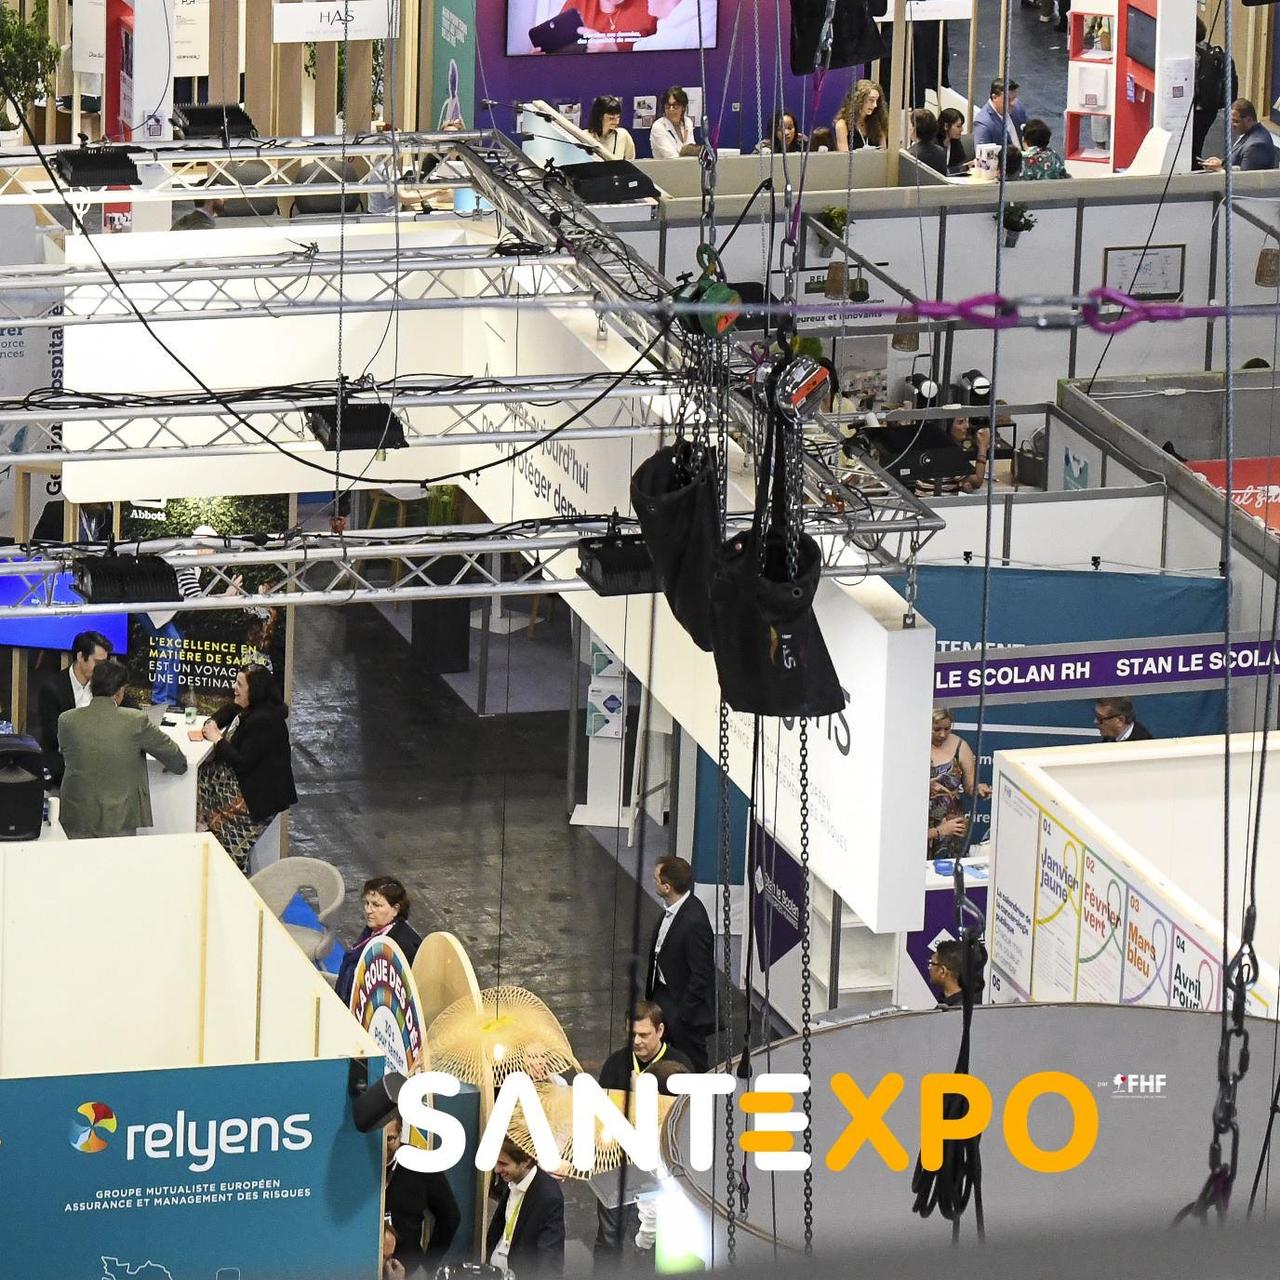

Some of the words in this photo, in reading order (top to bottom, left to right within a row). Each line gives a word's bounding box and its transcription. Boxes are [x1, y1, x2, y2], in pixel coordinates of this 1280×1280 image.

[319, 10, 354, 26] HAS
[130, 509, 167, 521] Abbott
[149, 636, 237, 653] L'EXCELLENCE
[149, 649, 202, 662] MATIÈRE
[205, 654, 223, 665] DE
[149, 660, 170, 671] EST
[172, 662, 191, 673] UN
[148, 672, 174, 684] UNE
[935, 670, 962, 690] LE
[967, 663, 1055, 688] SCOLAN
[1060, 660, 1091, 680] RH
[1115, 656, 1172, 678] STAN
[1177, 652, 1204, 672] LE
[1042, 818, 1052, 837] 01
[1040, 847, 1080, 892] Janvier
[1085, 854, 1096, 875] 02
[1039, 867, 1069, 904] jaune
[1082, 880, 1123, 931] Février
[1129, 894, 1141, 913] 03
[1082, 905, 1107, 940] vert
[1127, 921, 1157, 961] Mars
[1175, 935, 1186, 954] 04
[1126, 943, 1151, 979] bleu
[364, 958, 388, 995] ROUE
[389, 967, 407, 1010] DES
[991, 974, 1002, 993] 05
[1173, 962, 1202, 998] Avril
[126, 1109, 313, 1173] relyens
[95, 1187, 143, 1199] GROUPE
[145, 1183, 217, 1197] MUTUALISTE
[219, 1178, 281, 1191] EUROPÉEN
[64, 1199, 133, 1212] ASSURANCE
[136, 1198, 151, 1207] ET
[153, 1193, 235, 1207] MANAGEMENT
[237, 1191, 259, 1201] DES
[262, 1188, 312, 1200] RISQUES
